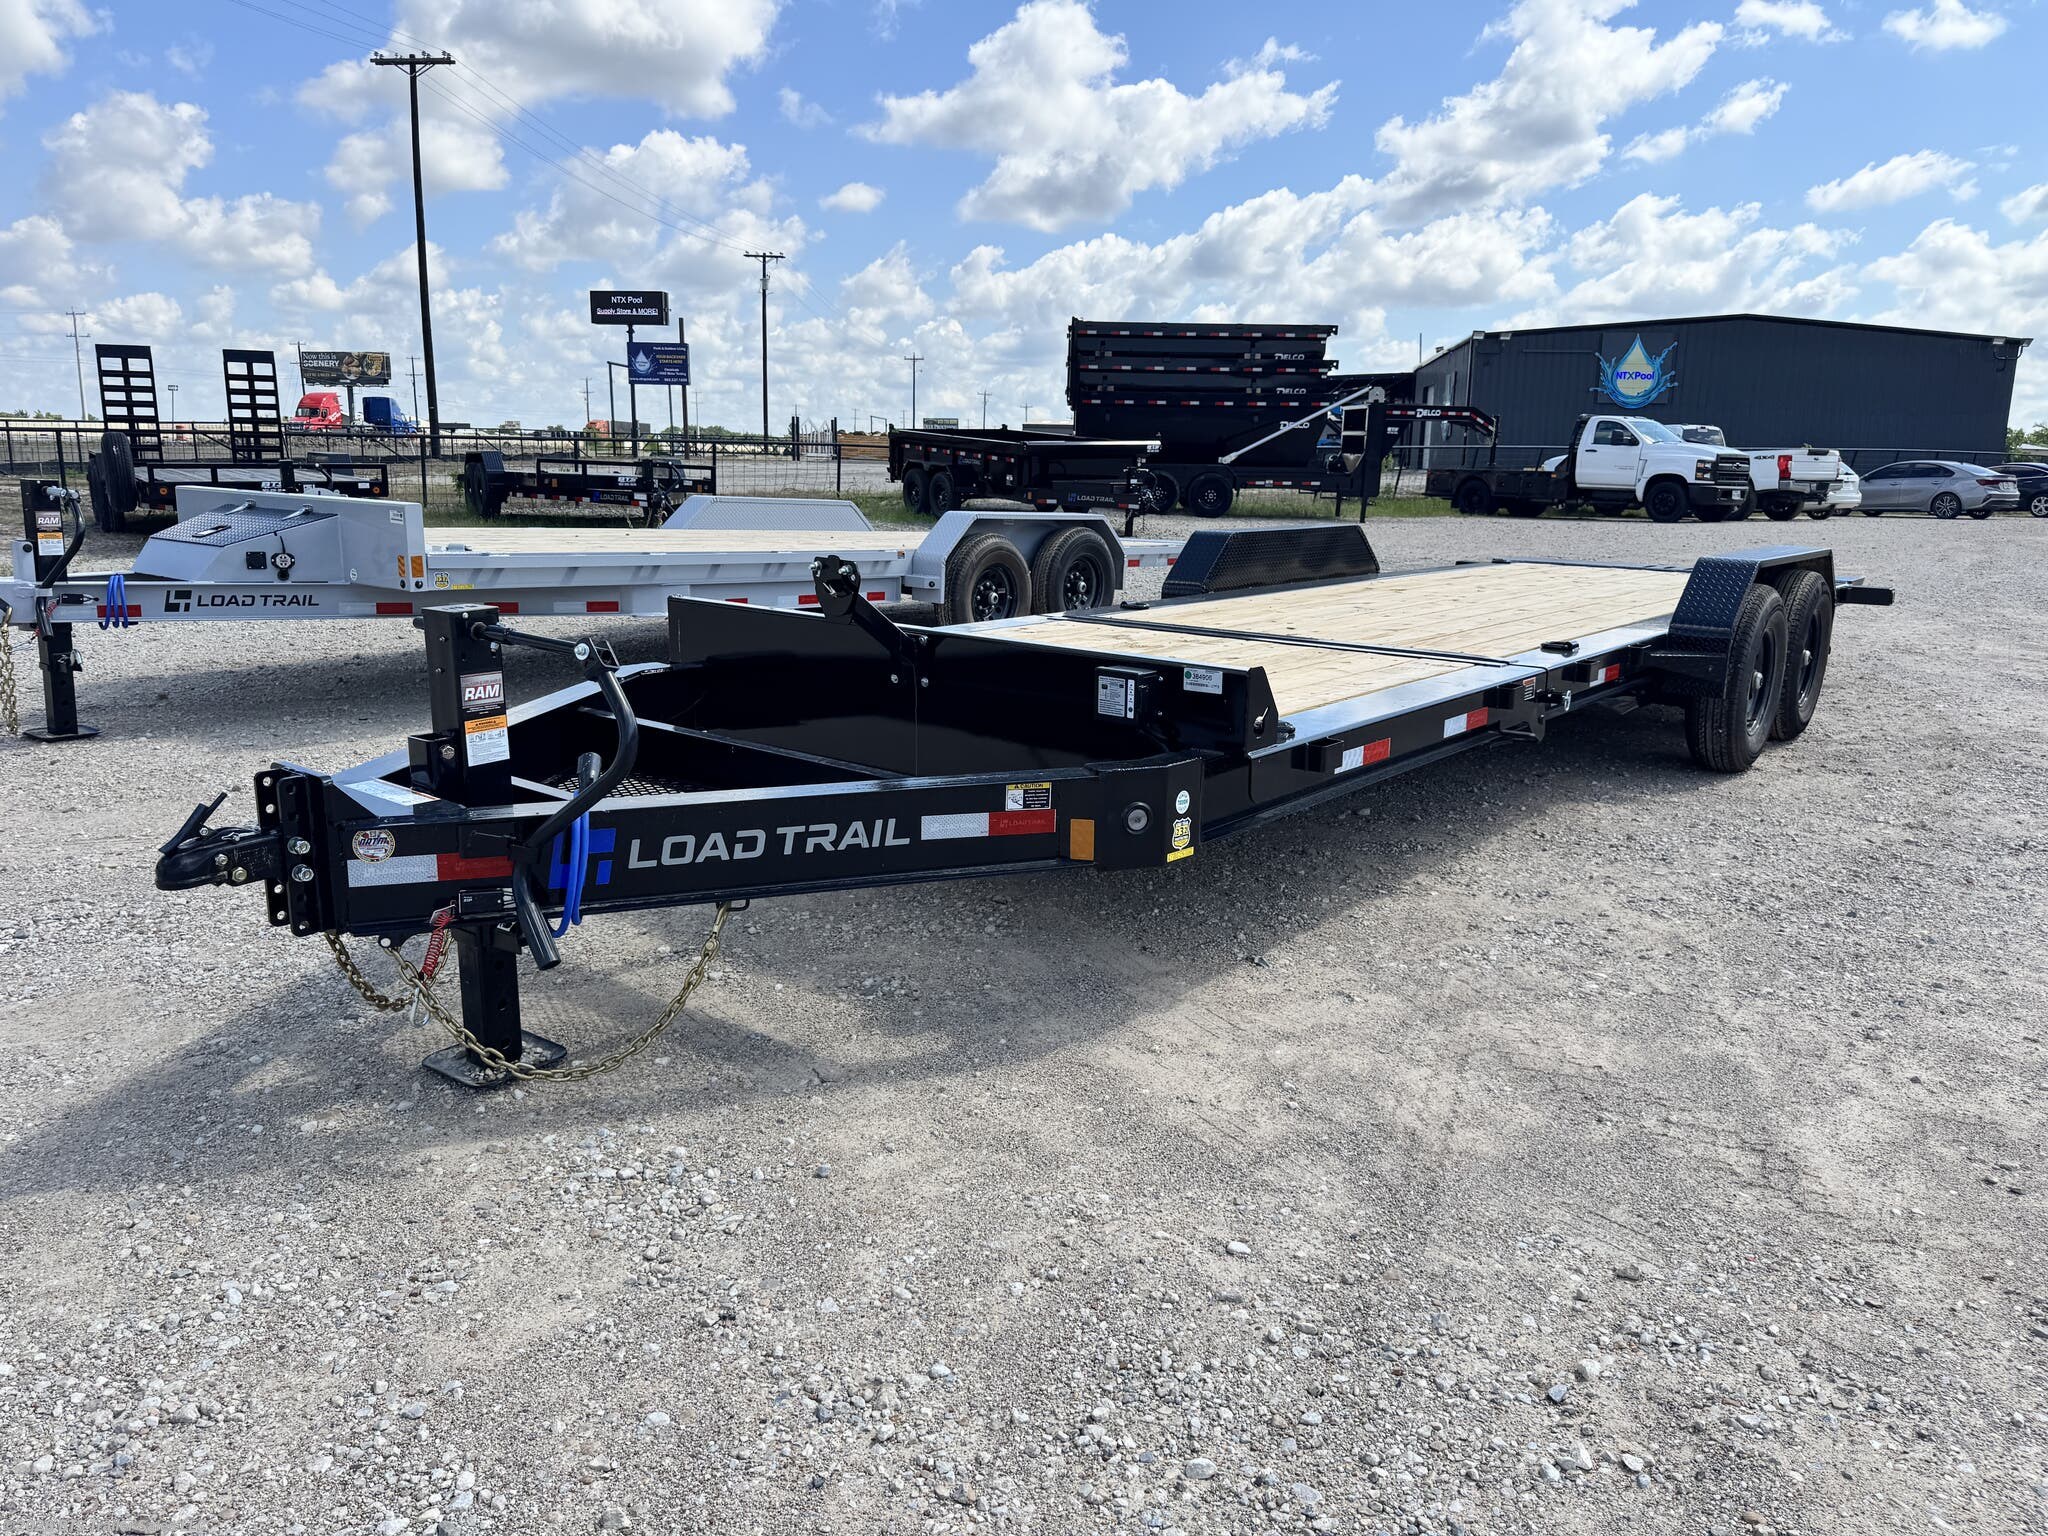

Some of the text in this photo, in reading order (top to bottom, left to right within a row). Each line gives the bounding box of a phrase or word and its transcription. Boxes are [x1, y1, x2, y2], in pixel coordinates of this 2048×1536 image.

[611, 296, 643, 304] NTX Pool
[596, 307, 616, 315] Supply
[616, 307, 632, 315] Store
[638, 308, 658, 316] MORE!
[318, 352, 331, 360] this
[331, 352, 337, 360] is
[1274, 353, 1305, 361] DELCO
[1616, 371, 1655, 380] NTXPool
[1416, 408, 1442, 418] DELCO
[38, 517, 59, 525] RAM
[197, 594, 319, 607] LOAD TRAIL
[464, 684, 500, 701] RAM
[628, 818, 911, 869] LOAD TRAIL
